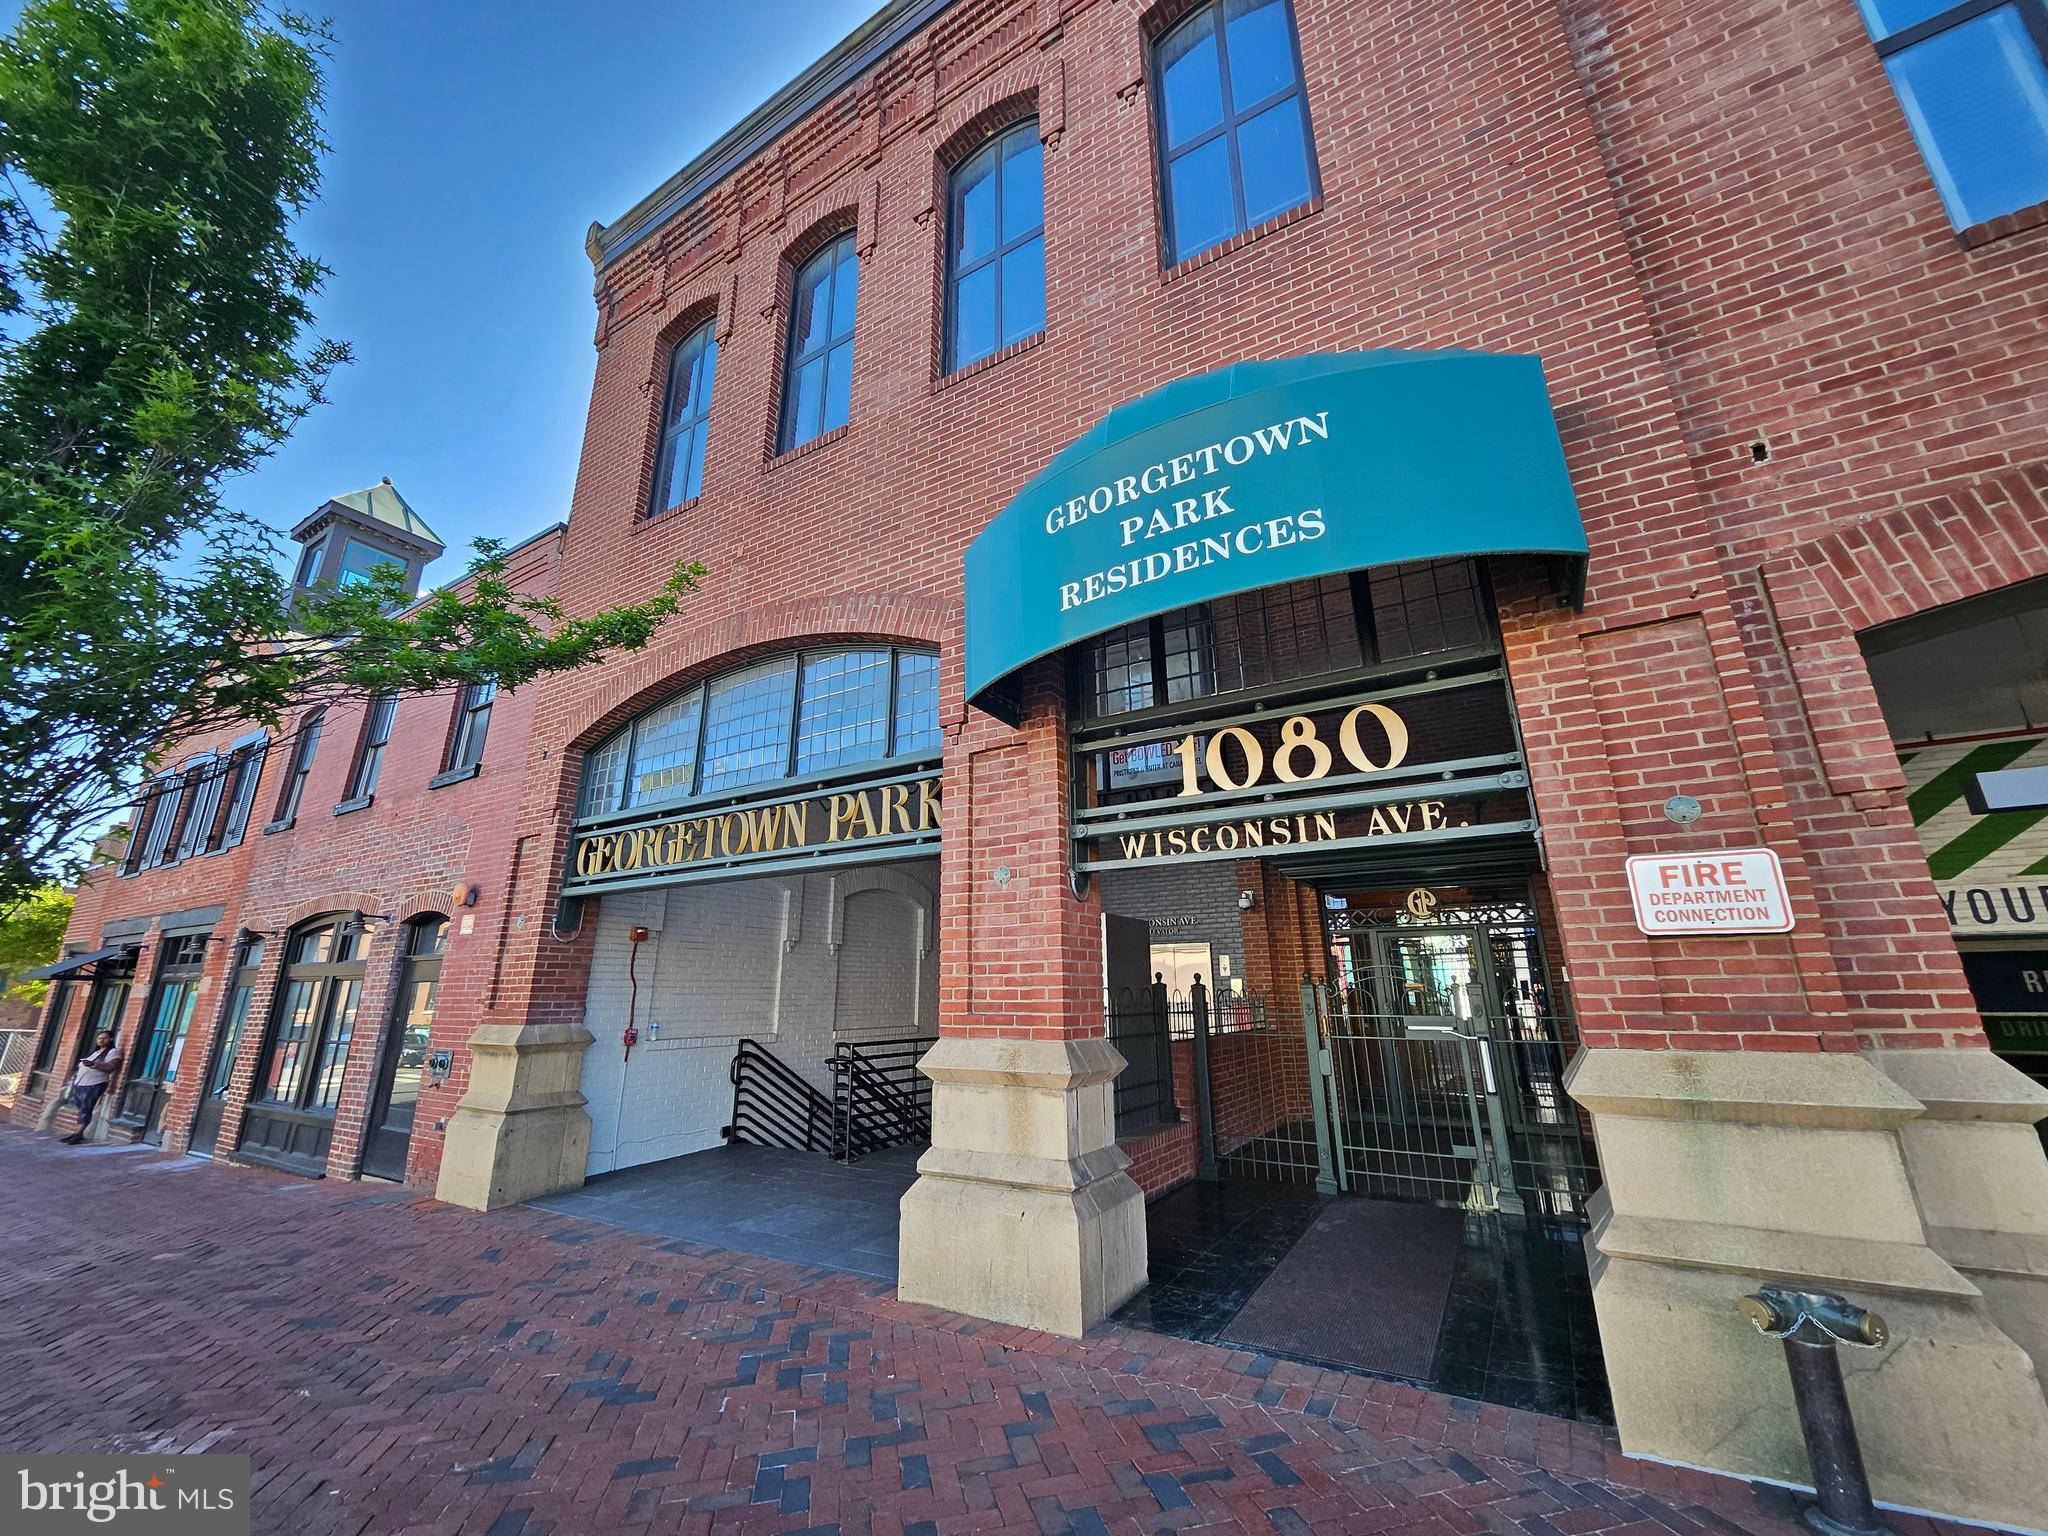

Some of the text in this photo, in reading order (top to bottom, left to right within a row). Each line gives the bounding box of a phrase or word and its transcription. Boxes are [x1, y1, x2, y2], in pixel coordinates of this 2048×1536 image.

[1044, 412, 1330, 535] GEORGETOWN
[1119, 485, 1235, 547] PARK
[1059, 508, 1327, 612] RESIDENCES
[1130, 742, 1173, 762] BOWLED
[1173, 703, 1410, 798] 1080
[577, 777, 943, 876] GEORGETOWN PARK
[1119, 800, 1469, 860] WISCONSIN AVE.
[1649, 888, 1768, 907] DEPARTMENT
[1658, 860, 1748, 889] FIRE
[1148, 917, 1177, 927] ONSIN
[1654, 905, 1770, 924] CONNECTION
